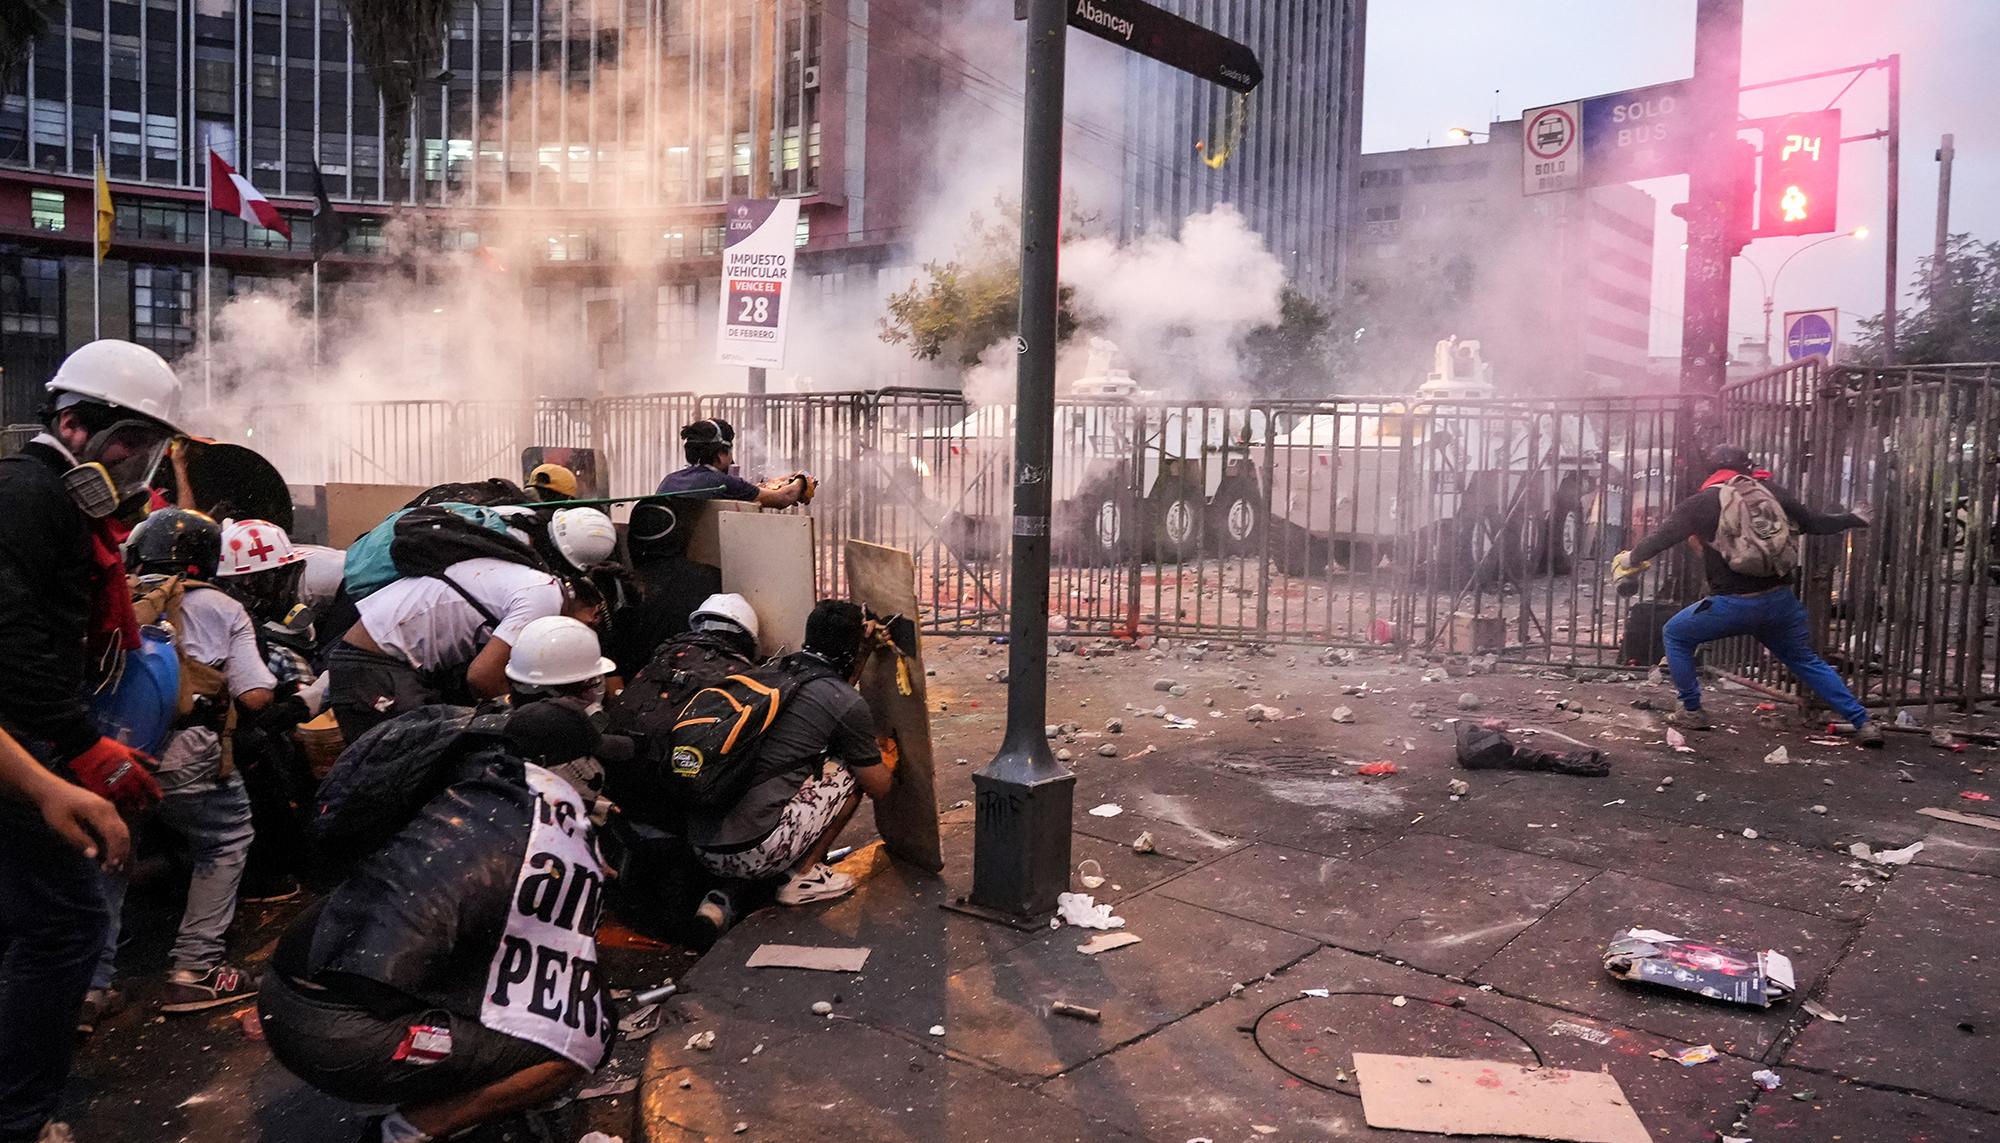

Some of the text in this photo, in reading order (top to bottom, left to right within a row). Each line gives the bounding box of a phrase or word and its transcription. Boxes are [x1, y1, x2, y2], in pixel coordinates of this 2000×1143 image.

[1076, 0, 1134, 40] Abancay
[1613, 96, 1676, 123] SOLO
[1617, 123, 1666, 147] BUS
[1782, 135, 1821, 161] 24
[1535, 160, 1566, 176] SOLO
[730, 222, 752, 230] LIMA
[731, 253, 786, 267] IMPUESTO
[727, 266, 787, 279] VEHICULAR
[735, 281, 776, 292] VENCE EL
[738, 296, 769, 323] 28
[728, 328, 775, 339] DE FEBRERO
[491, 934, 610, 1043] PER
